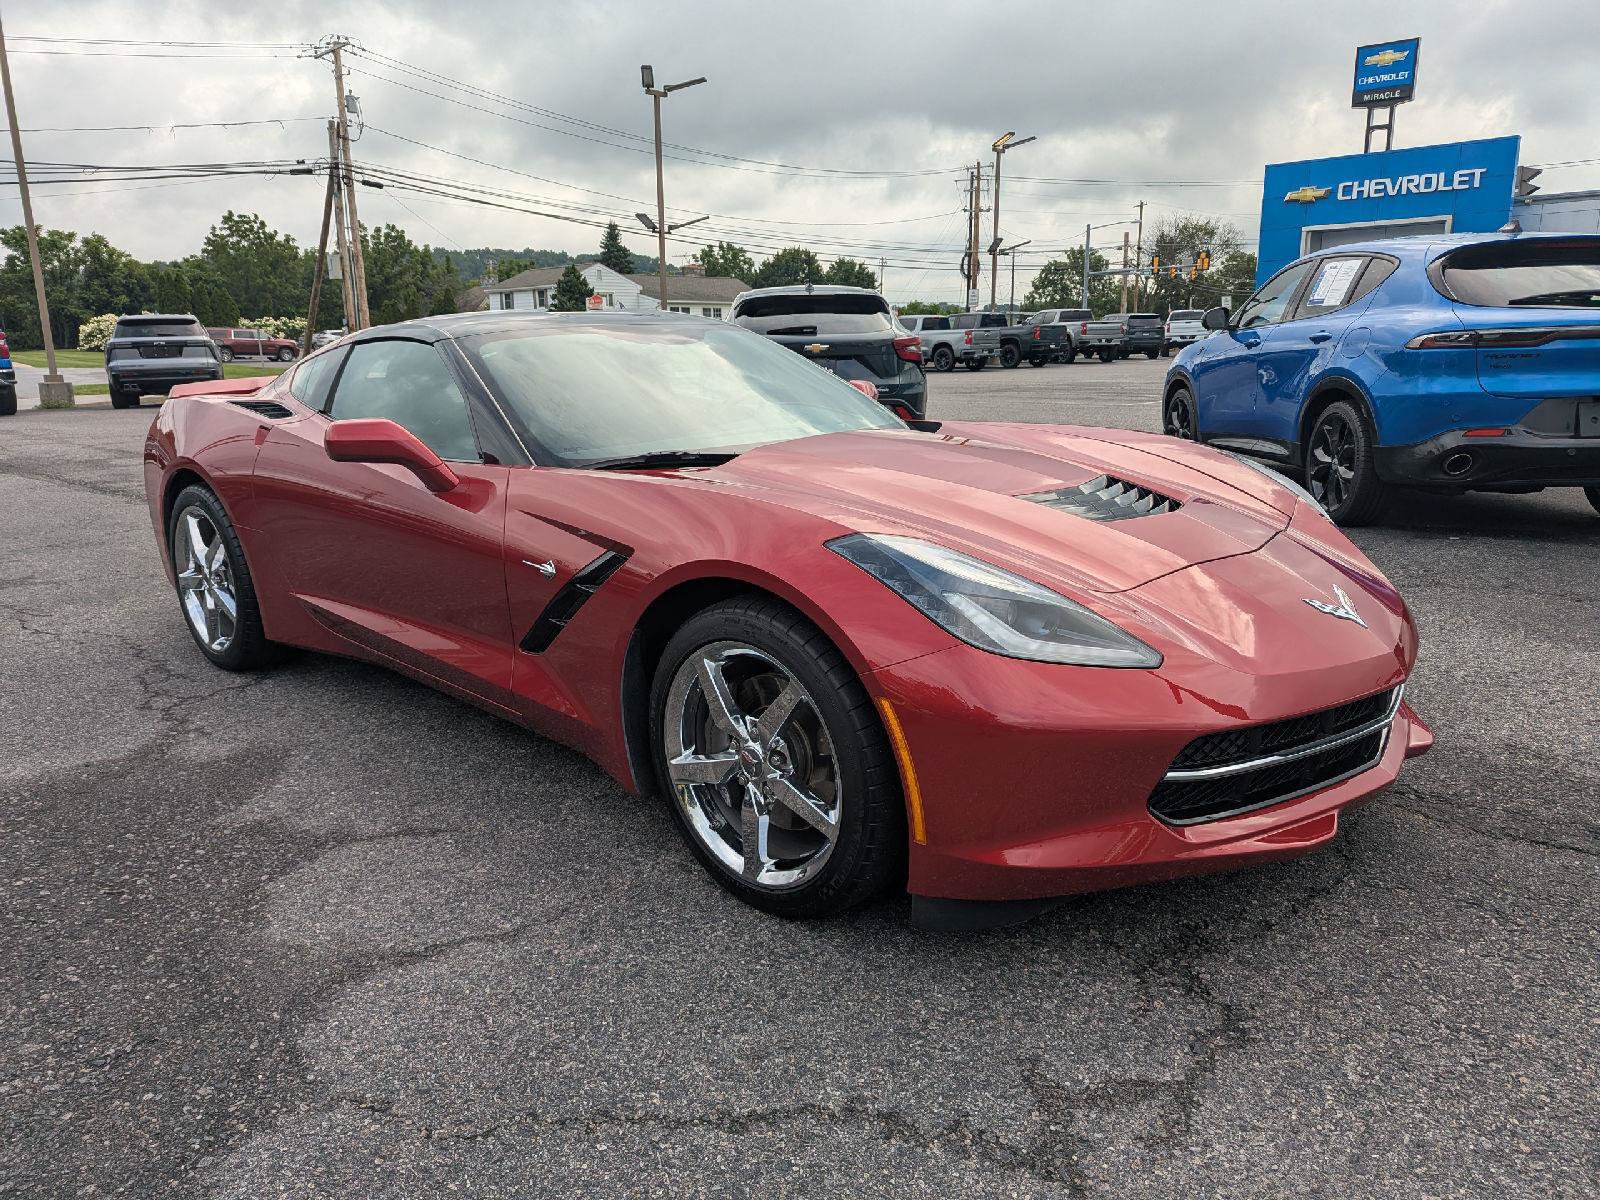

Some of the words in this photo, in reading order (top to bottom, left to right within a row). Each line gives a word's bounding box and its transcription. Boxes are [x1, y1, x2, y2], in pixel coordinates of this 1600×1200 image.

[1358, 71, 1410, 85] CHEVROLET
[1363, 90, 1401, 102] MIRACLE
[1336, 167, 1487, 201] CHEVROLET
